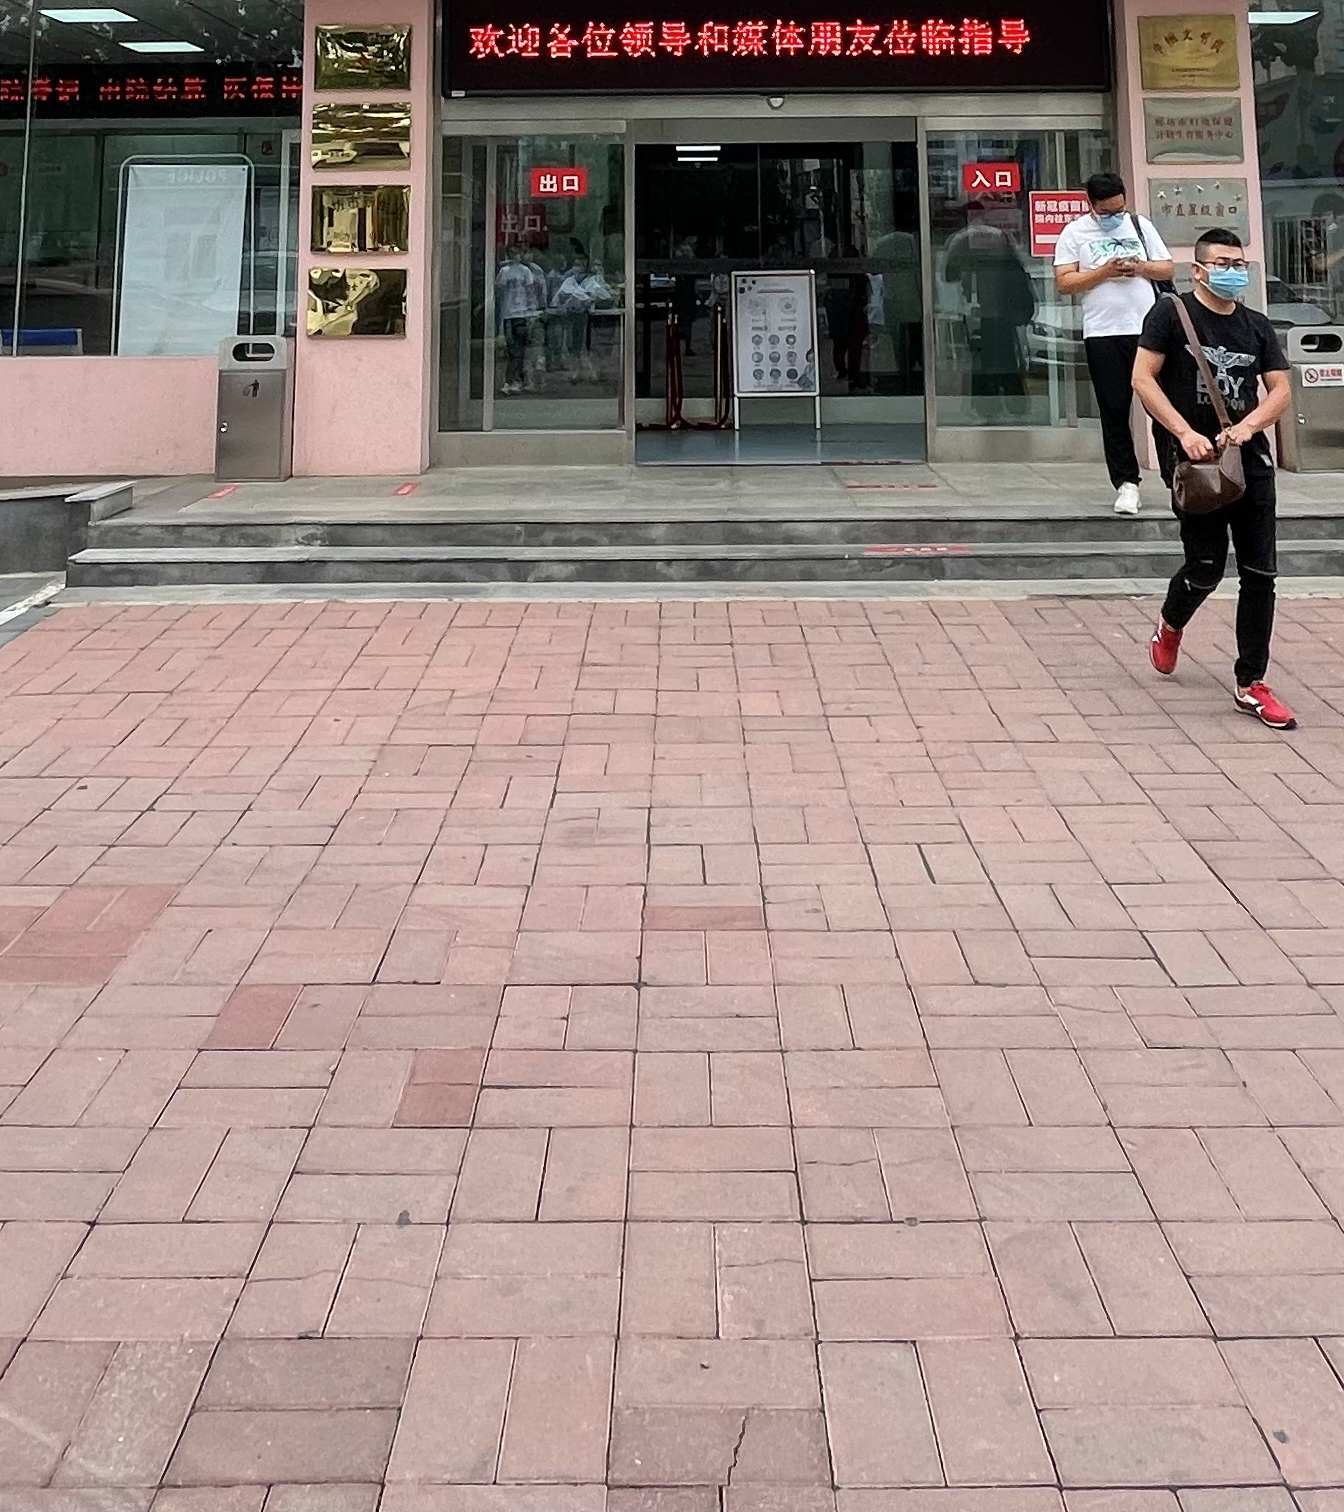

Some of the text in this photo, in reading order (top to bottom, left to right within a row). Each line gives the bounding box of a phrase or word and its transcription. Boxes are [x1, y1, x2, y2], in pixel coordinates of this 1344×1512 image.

[469, 19, 1030, 58] 欢迎各位领导和媒体朋友莅临指导
[540, 174, 579, 192] 出口
[971, 170, 1012, 188] 入口
[1197, 393, 1245, 411] LOON
